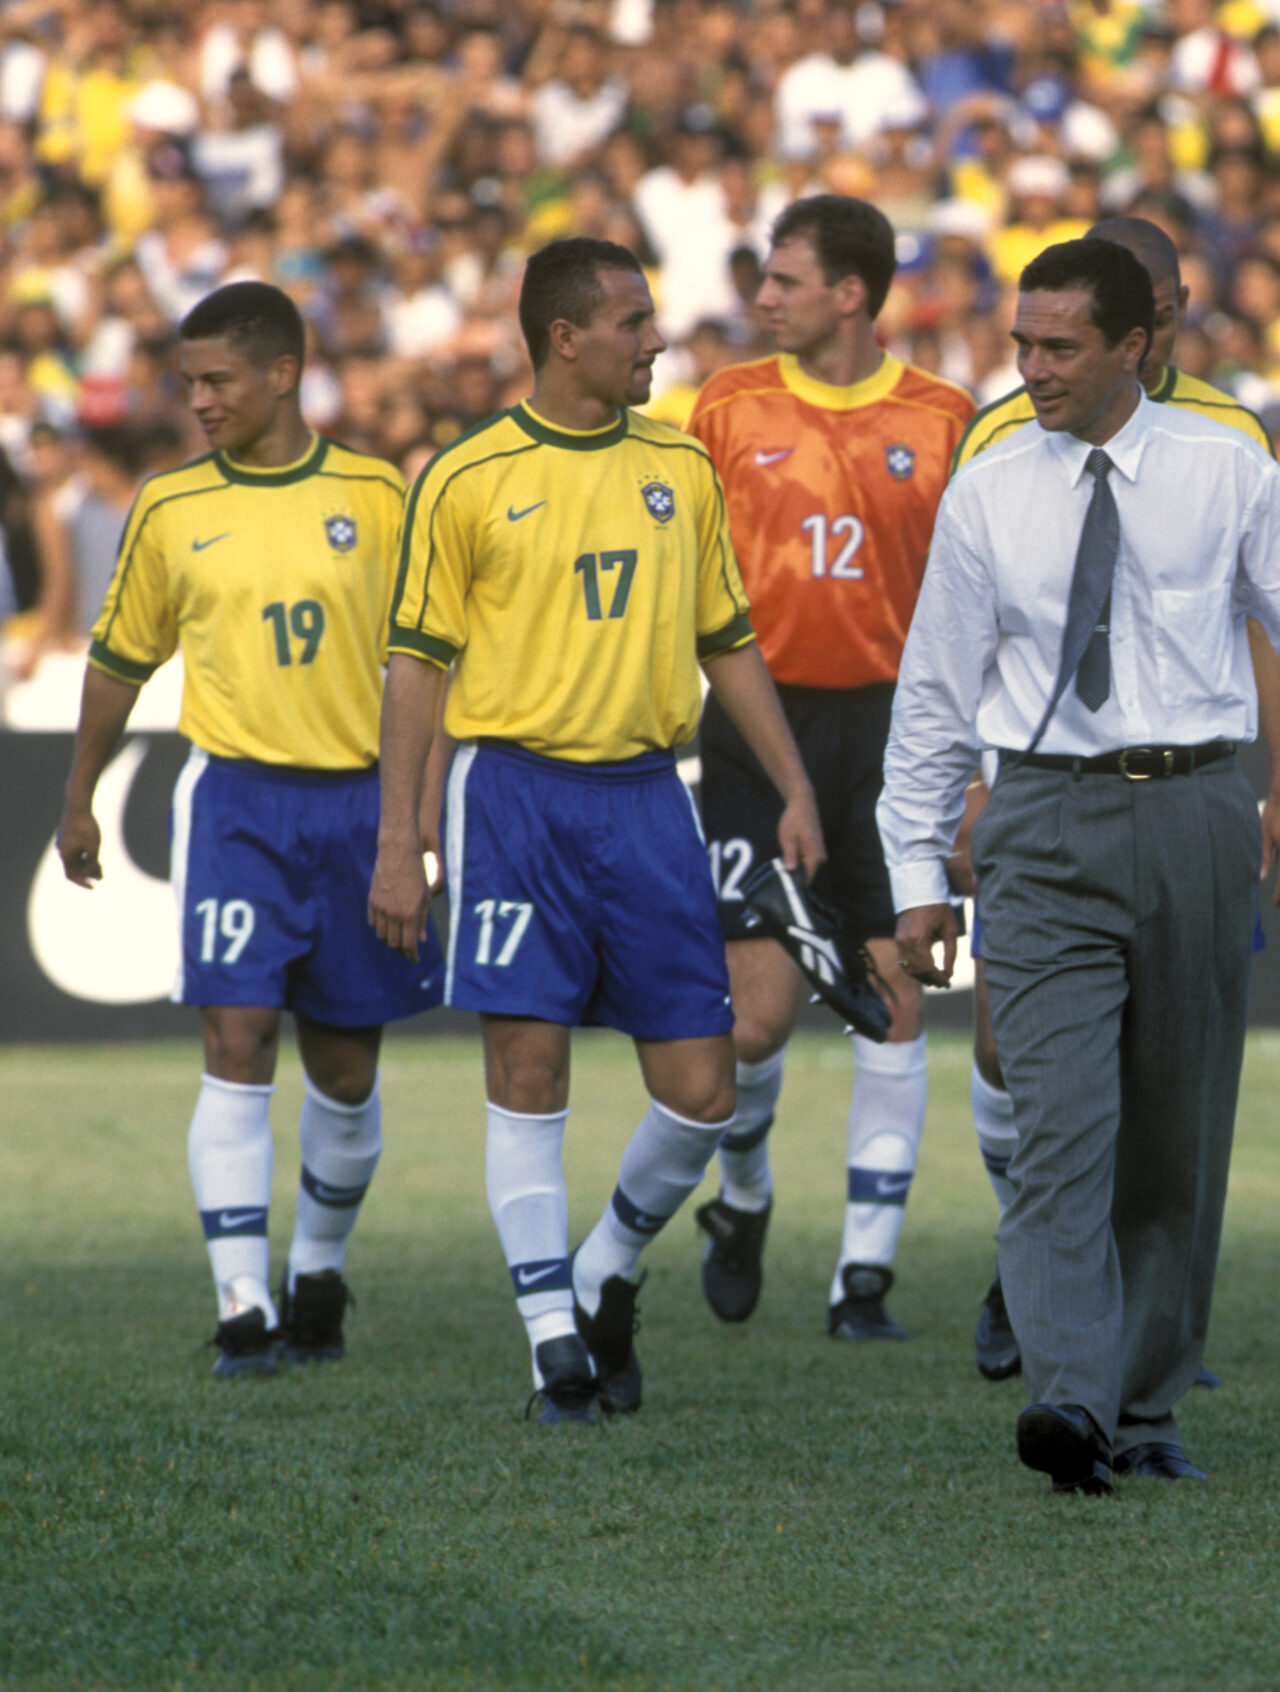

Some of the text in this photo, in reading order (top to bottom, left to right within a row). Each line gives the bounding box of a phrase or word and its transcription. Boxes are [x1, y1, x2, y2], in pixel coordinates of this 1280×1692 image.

[802, 514, 865, 578] 12
[574, 549, 638, 620] 17
[263, 599, 325, 666] 19
[708, 837, 753, 902] 12
[196, 898, 255, 963] 19
[474, 899, 534, 966] 17
